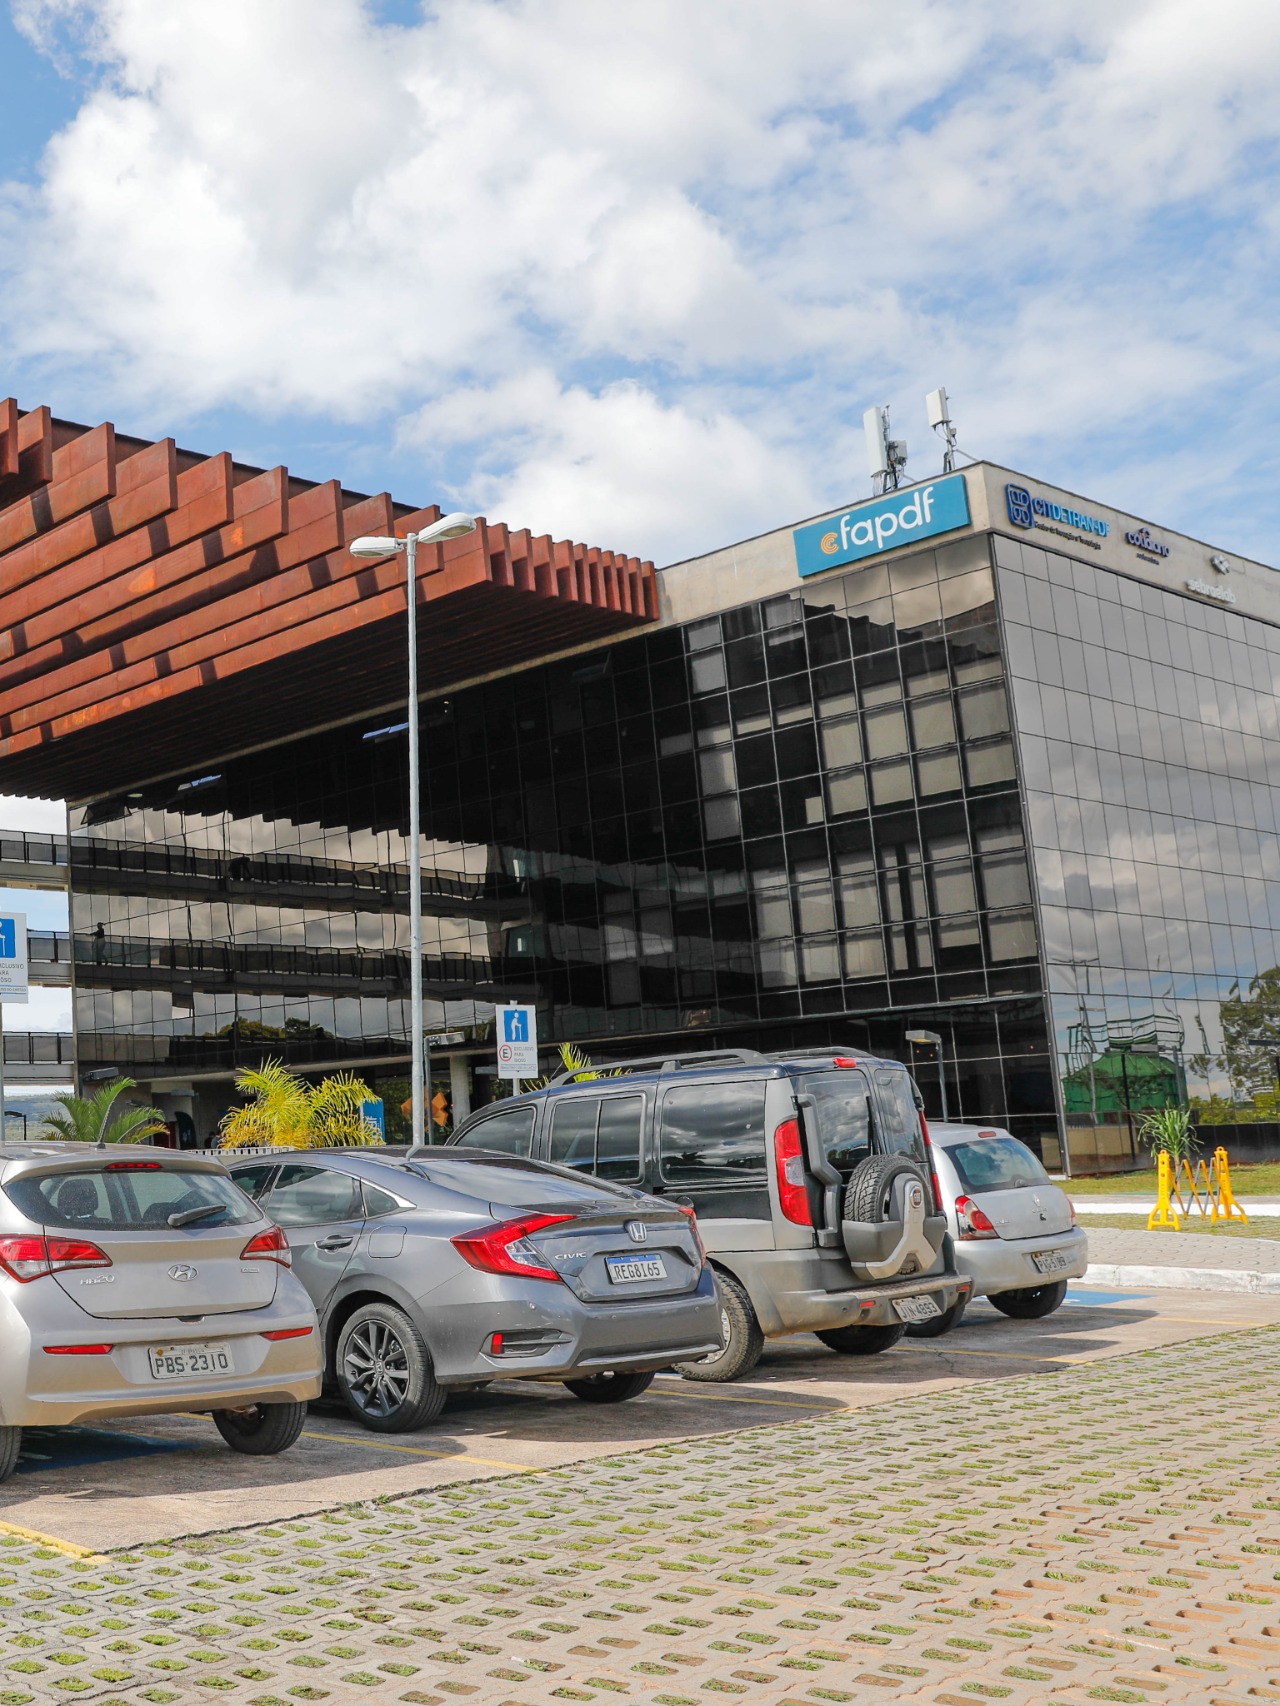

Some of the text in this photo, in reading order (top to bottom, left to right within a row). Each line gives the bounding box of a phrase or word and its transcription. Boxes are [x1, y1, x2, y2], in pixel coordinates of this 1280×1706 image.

[840, 486, 934, 550] fapdf
[554, 1252, 587, 1260] CIVIC
[80, 1274, 115, 1285] HB20
